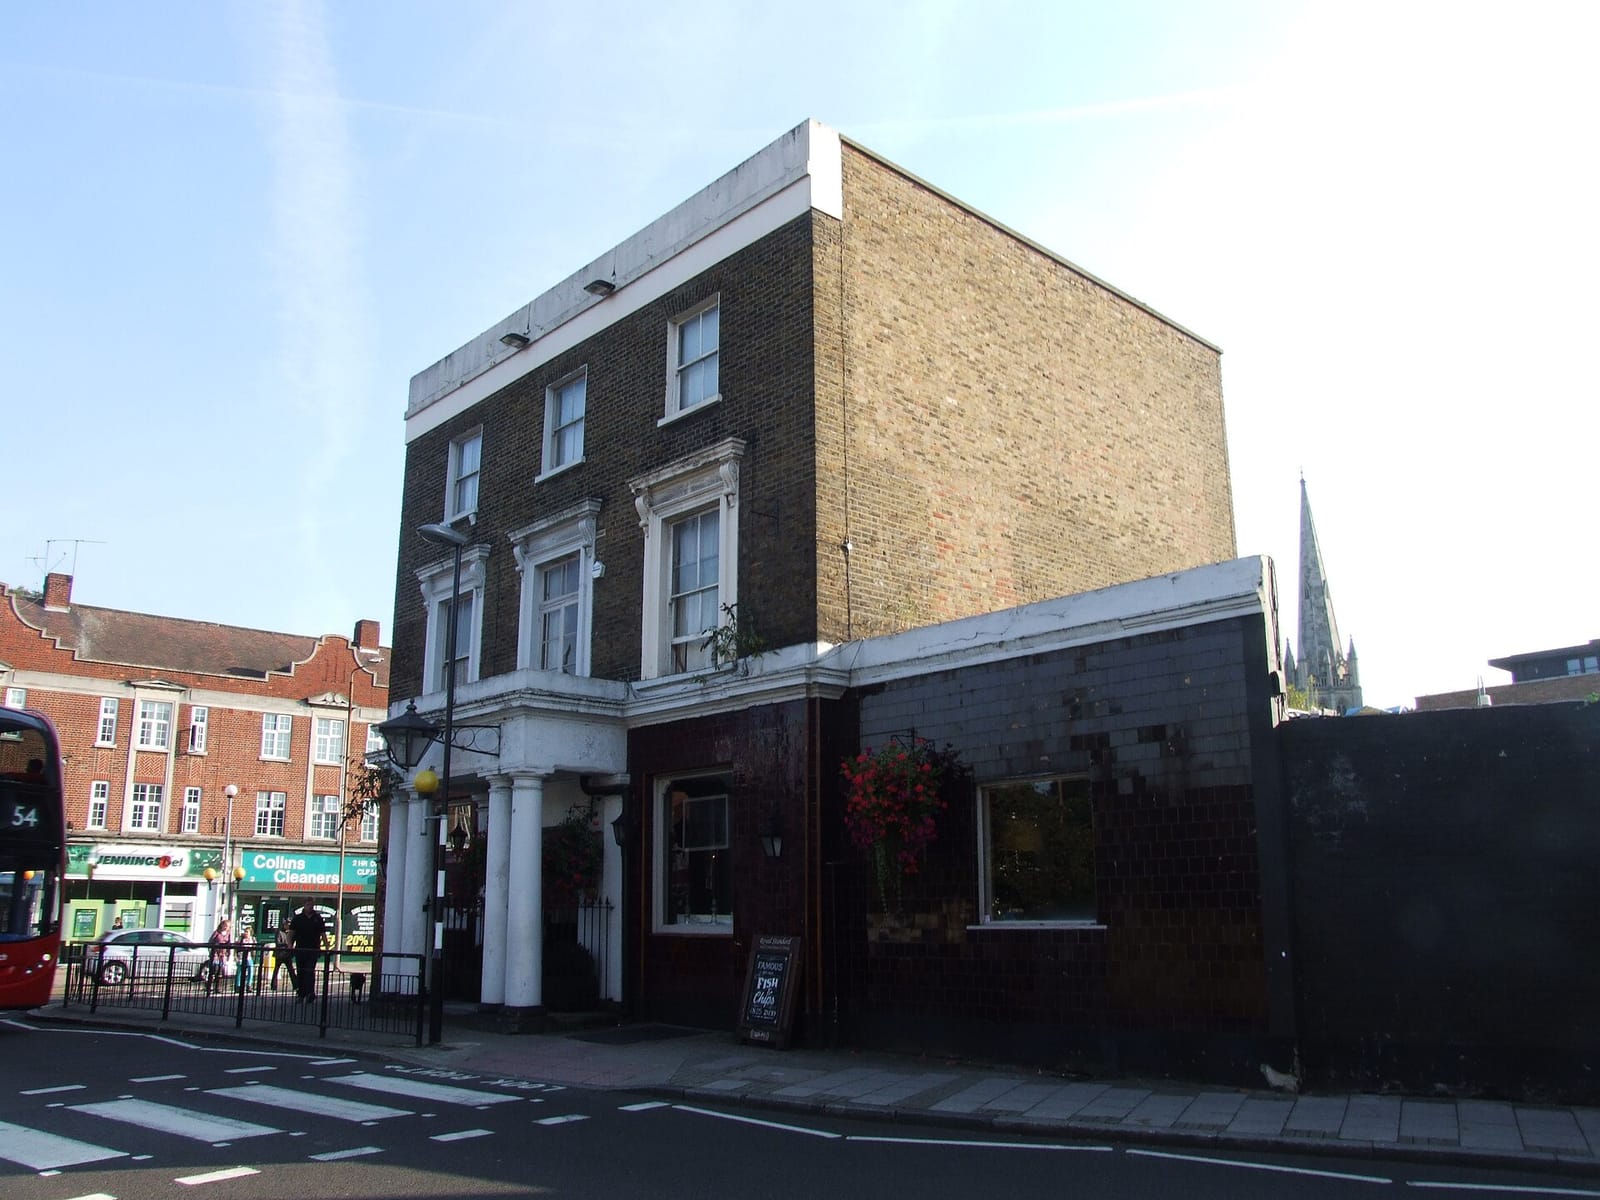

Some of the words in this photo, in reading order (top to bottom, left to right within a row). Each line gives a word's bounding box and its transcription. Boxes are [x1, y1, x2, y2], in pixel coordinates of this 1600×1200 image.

[12, 806, 38, 827] 54
[253, 855, 306, 870] Collins
[274, 870, 340, 884] Cleaners
[346, 935, 368, 946] 20%
[756, 977, 778, 989] FISH
[753, 991, 775, 1008] Chips
